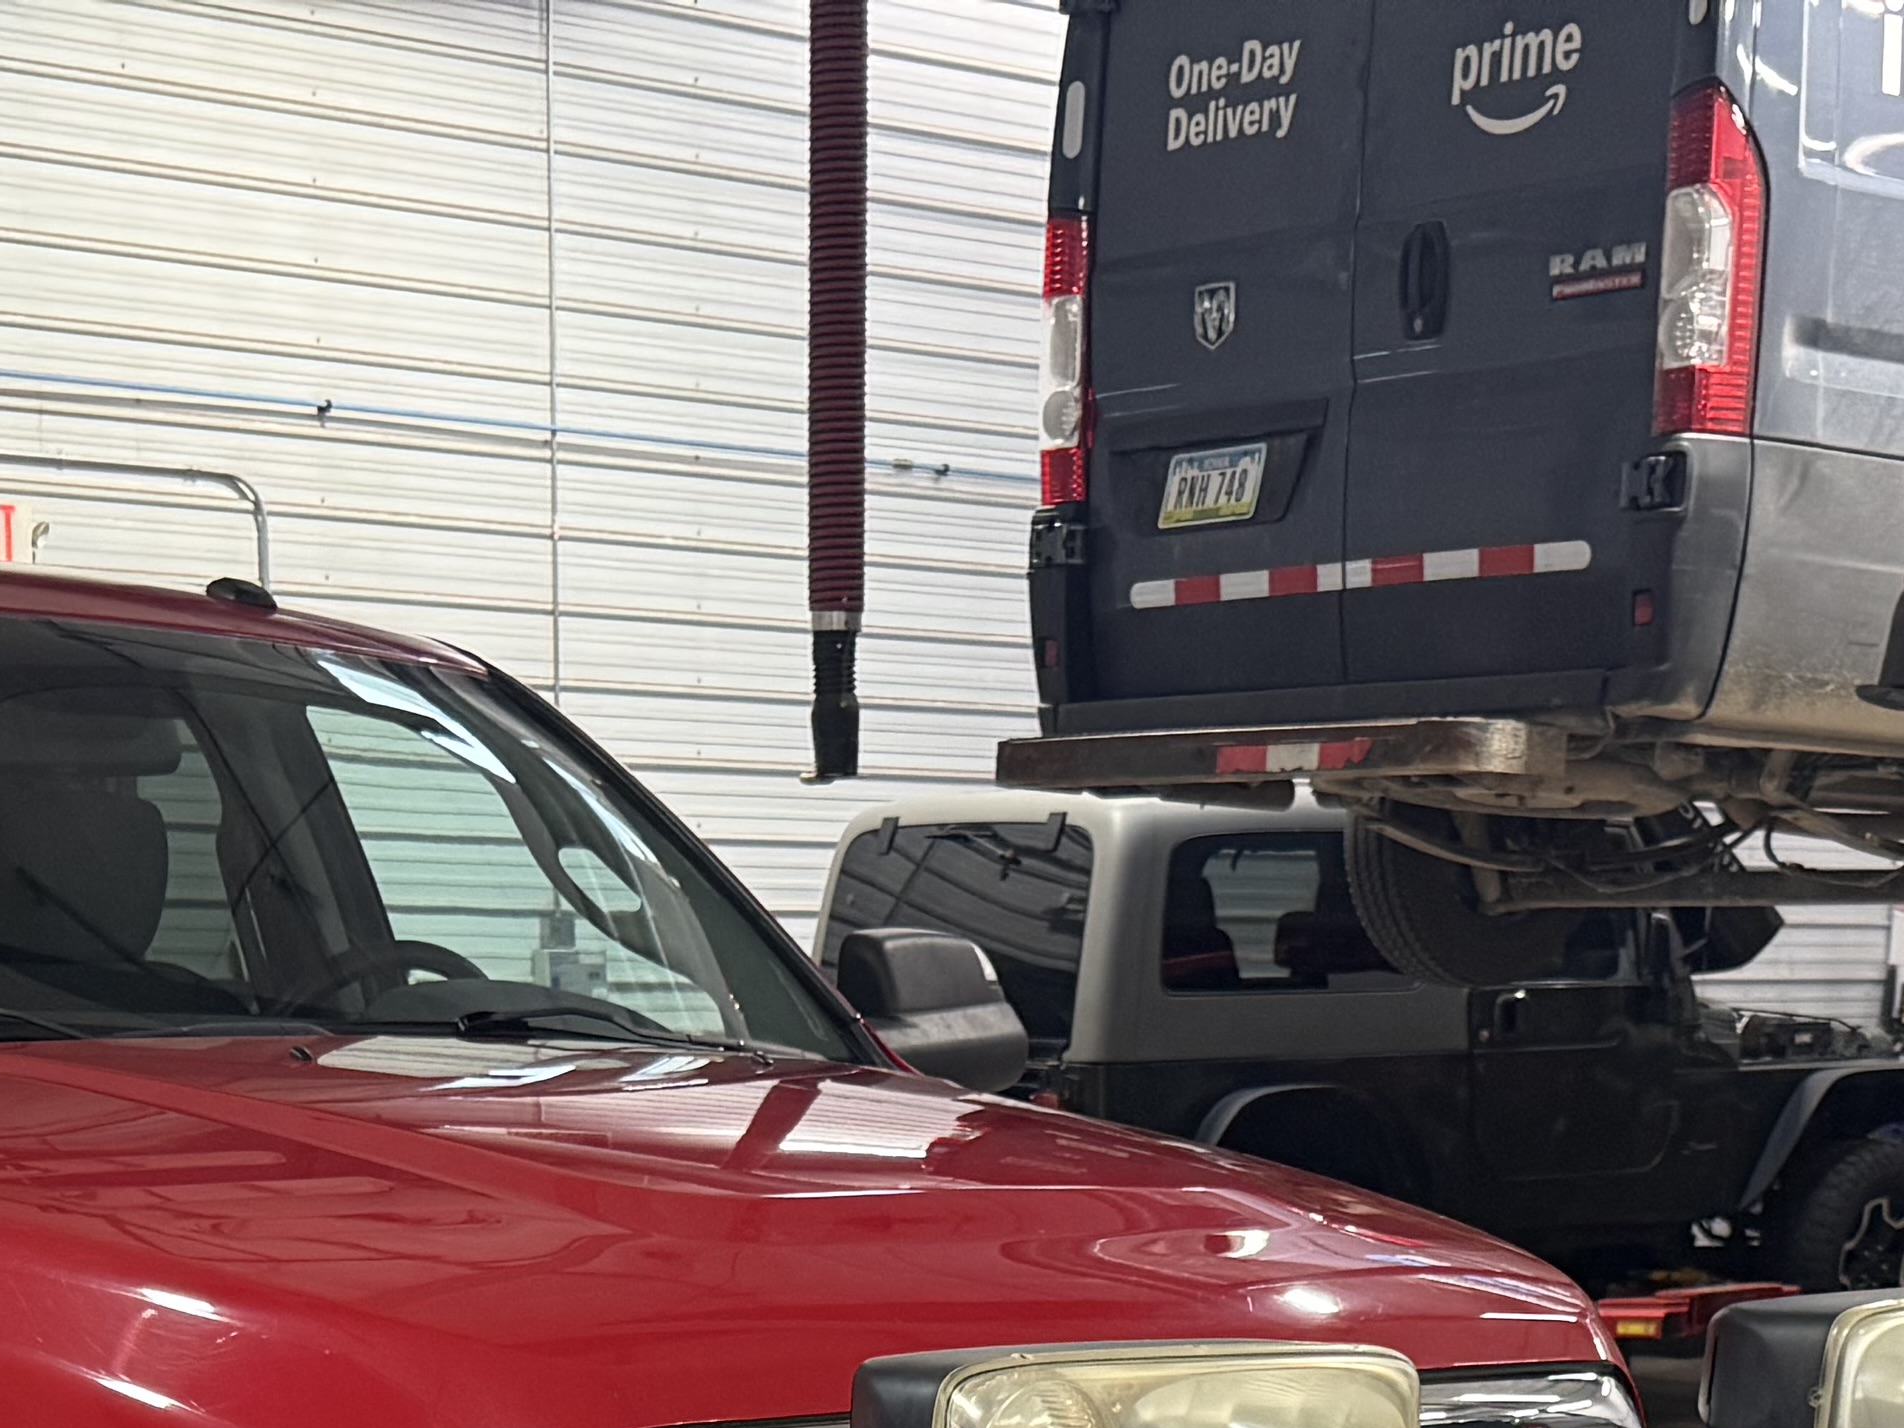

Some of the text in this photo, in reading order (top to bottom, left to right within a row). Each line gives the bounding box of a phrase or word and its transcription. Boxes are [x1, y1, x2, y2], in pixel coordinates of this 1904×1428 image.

[1168, 39, 1301, 98] One-Day
[1451, 21, 1582, 105] prime
[1167, 93, 1297, 151] Delivery
[1549, 242, 1647, 276] RAM
[1213, 468, 1248, 505] 748
